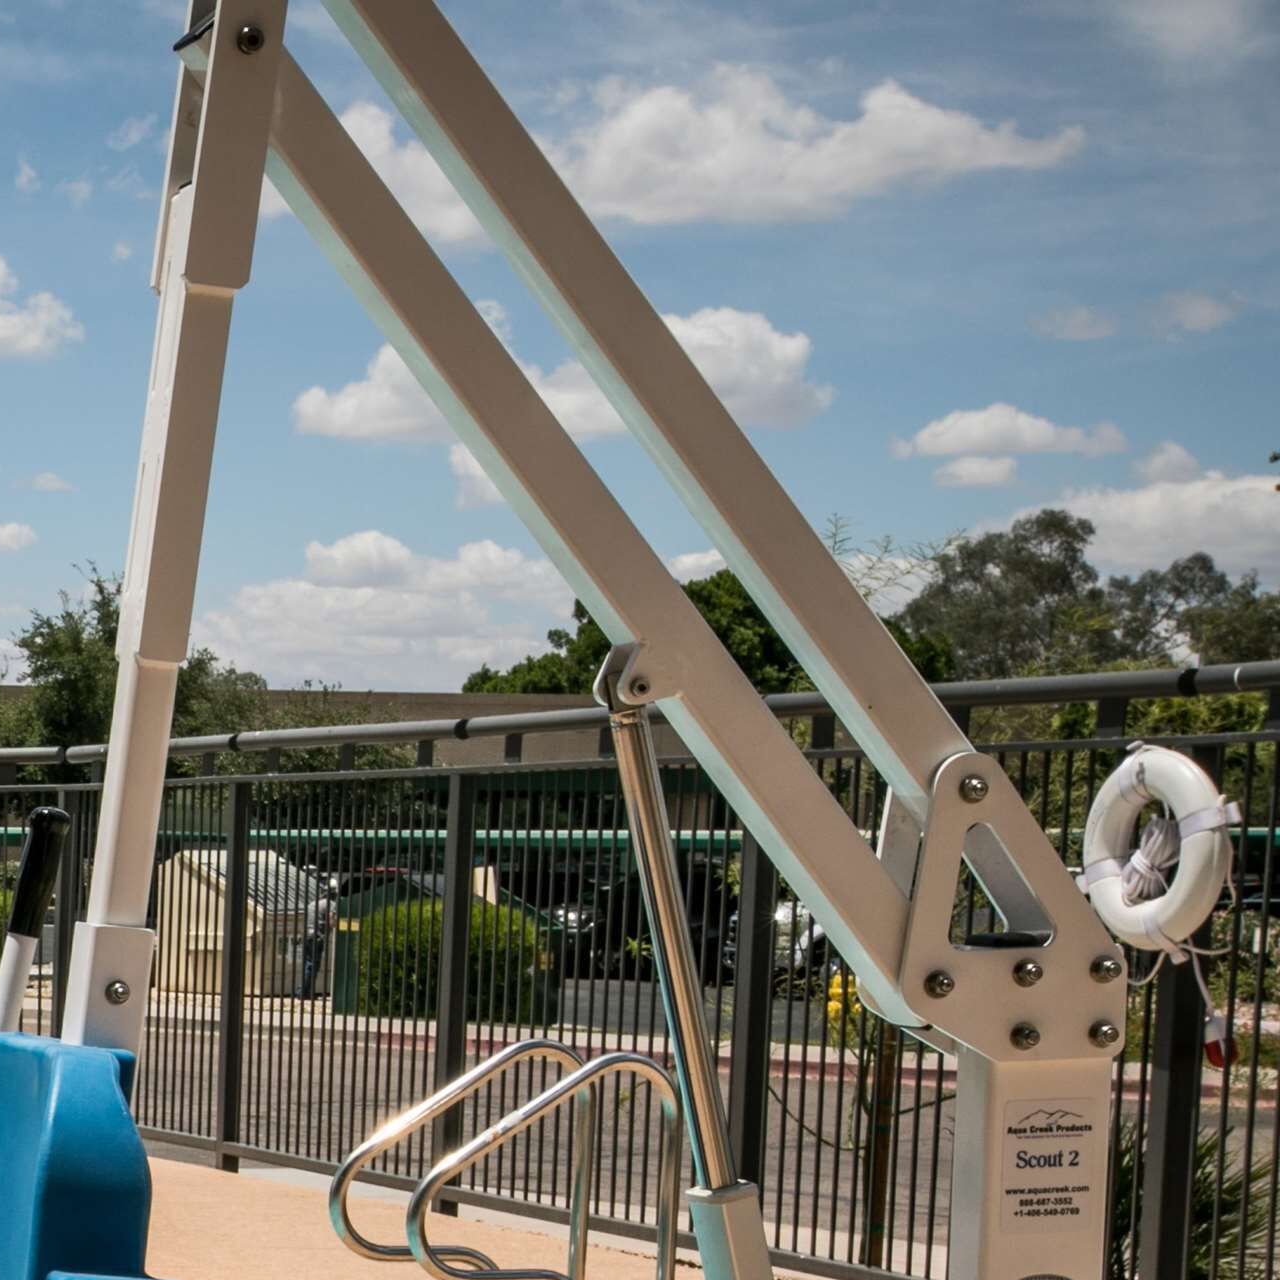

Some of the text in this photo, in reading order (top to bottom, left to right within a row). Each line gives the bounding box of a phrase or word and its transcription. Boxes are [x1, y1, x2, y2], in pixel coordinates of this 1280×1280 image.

[1007, 1124, 1092, 1135] Aqua Creek Products
[1016, 1149, 1079, 1169] Scout 2
[1005, 1185, 1089, 1196] www.aquacreek.com
